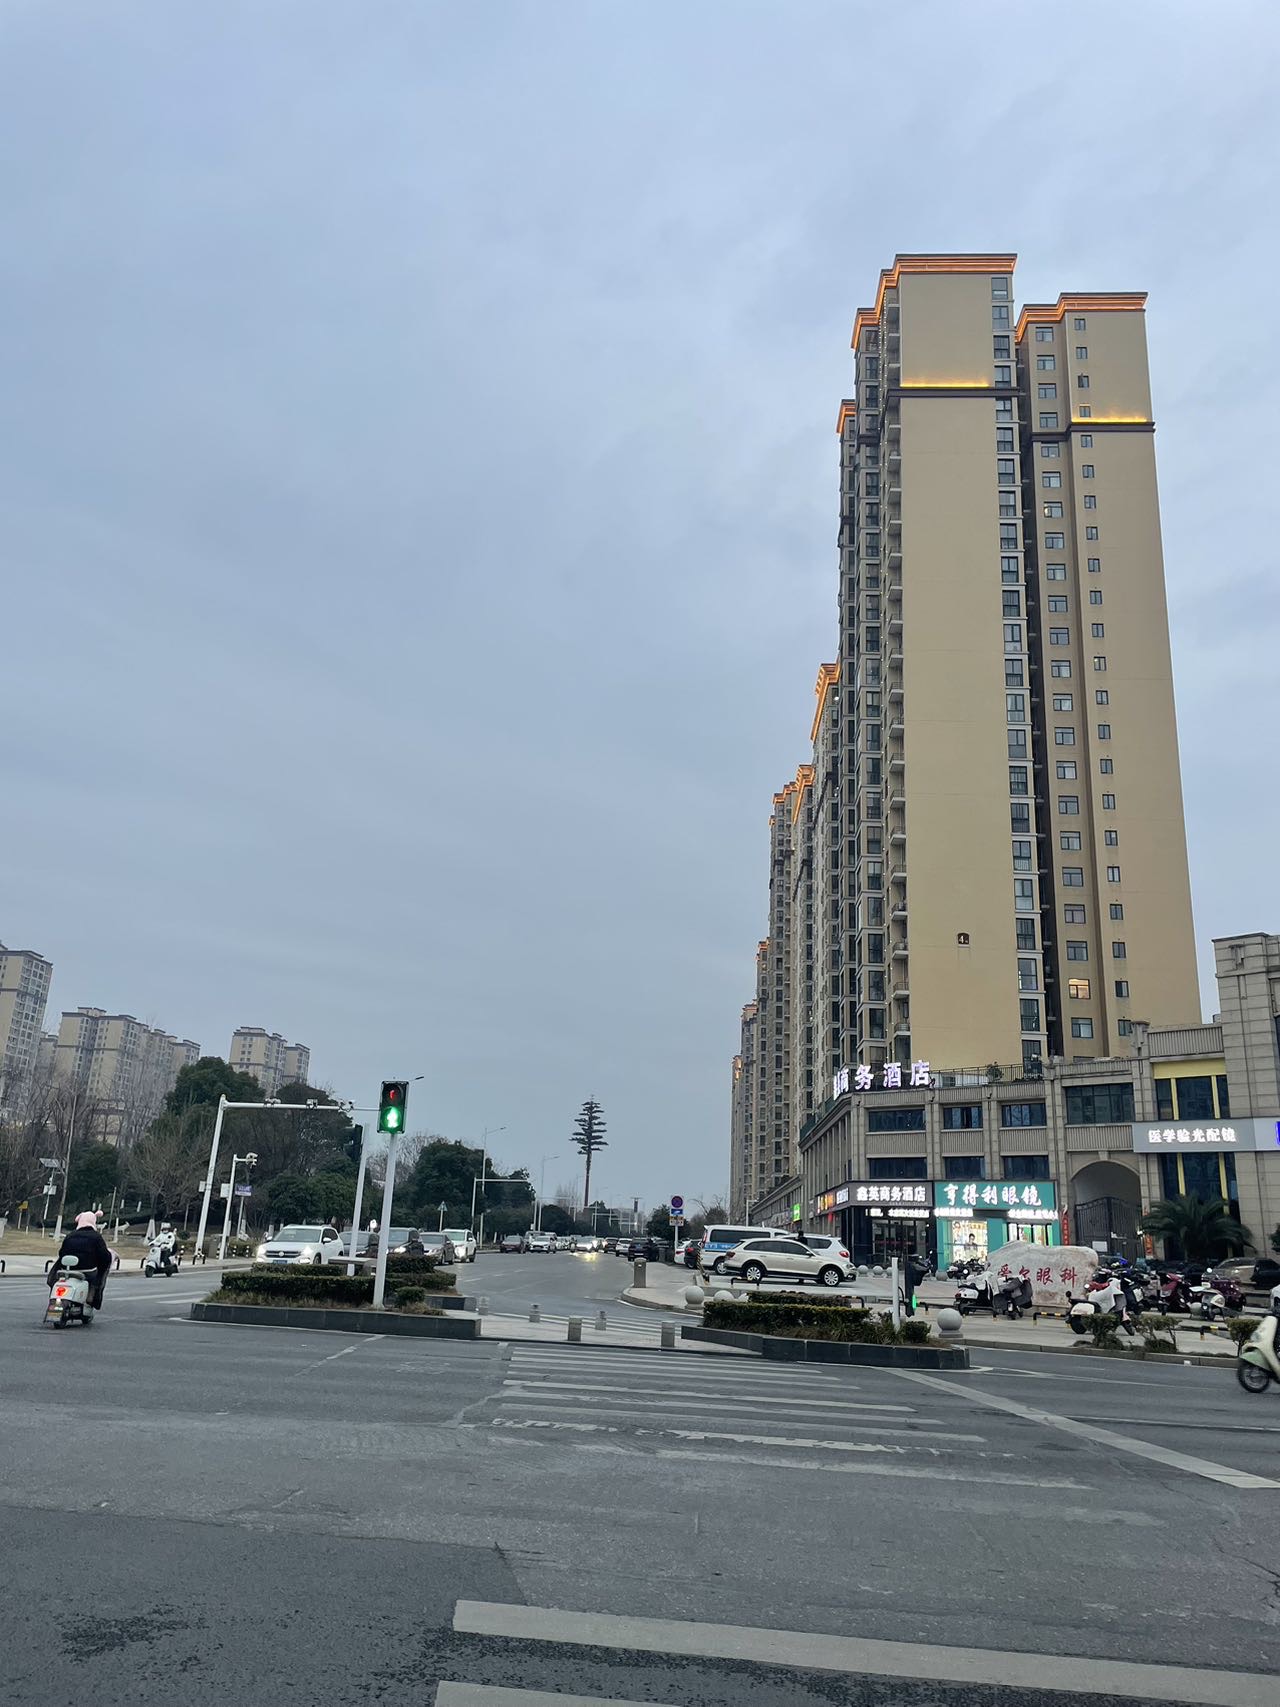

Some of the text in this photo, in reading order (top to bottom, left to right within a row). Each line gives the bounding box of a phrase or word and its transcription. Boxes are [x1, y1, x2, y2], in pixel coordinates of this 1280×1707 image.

[1148, 1127, 1237, 1143] 医学验光配镜
[857, 1186, 926, 1202] 鑫英商务酒店
[943, 1183, 1042, 1206] 亨得利眼镜
